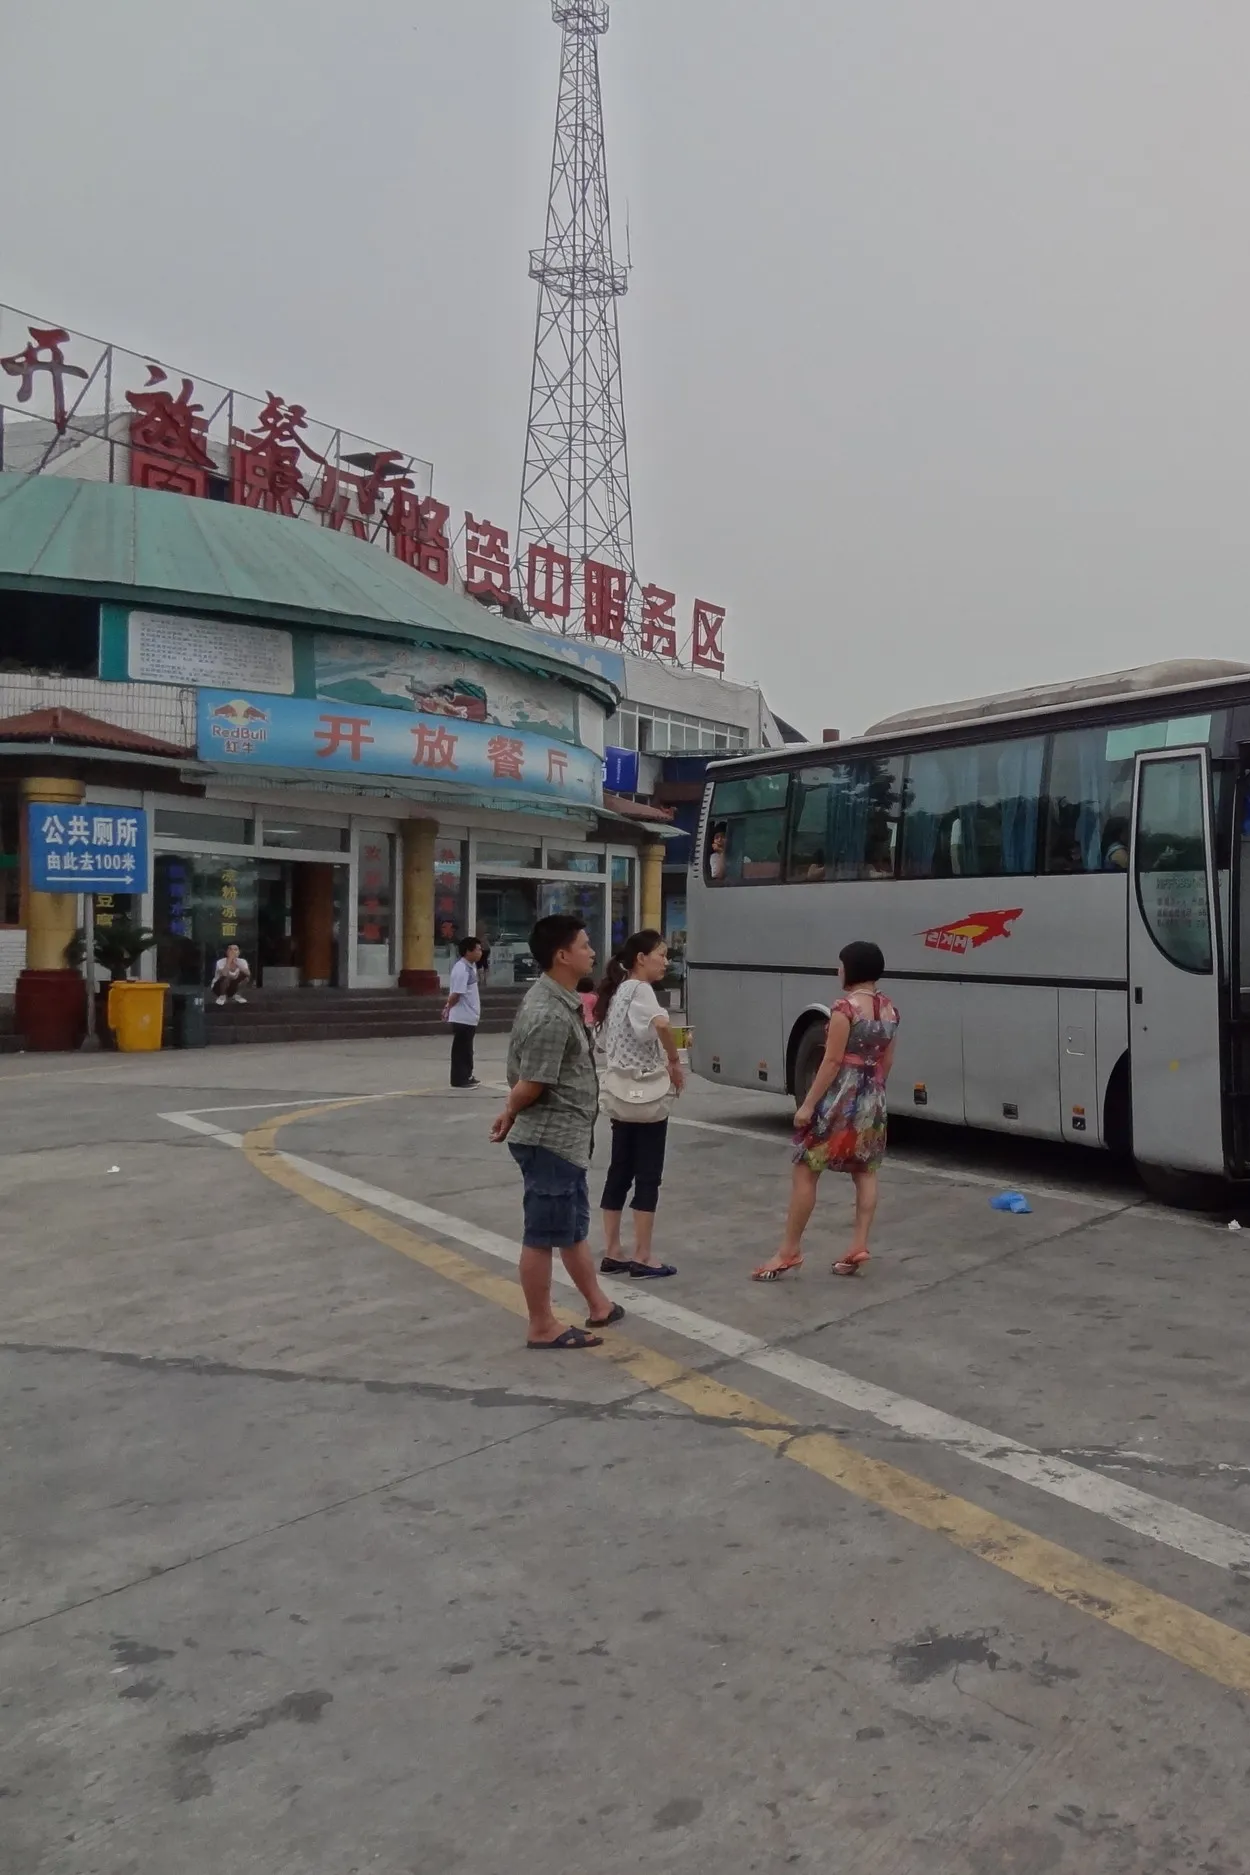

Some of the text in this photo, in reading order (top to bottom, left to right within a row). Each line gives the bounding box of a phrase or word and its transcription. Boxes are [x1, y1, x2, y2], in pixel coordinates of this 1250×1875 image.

[225, 741, 253, 754] 红牛
[314, 714, 569, 786] 开放餐厅
[42, 815, 138, 848] 公共厕所
[47, 851, 136, 872] 由此去100米
